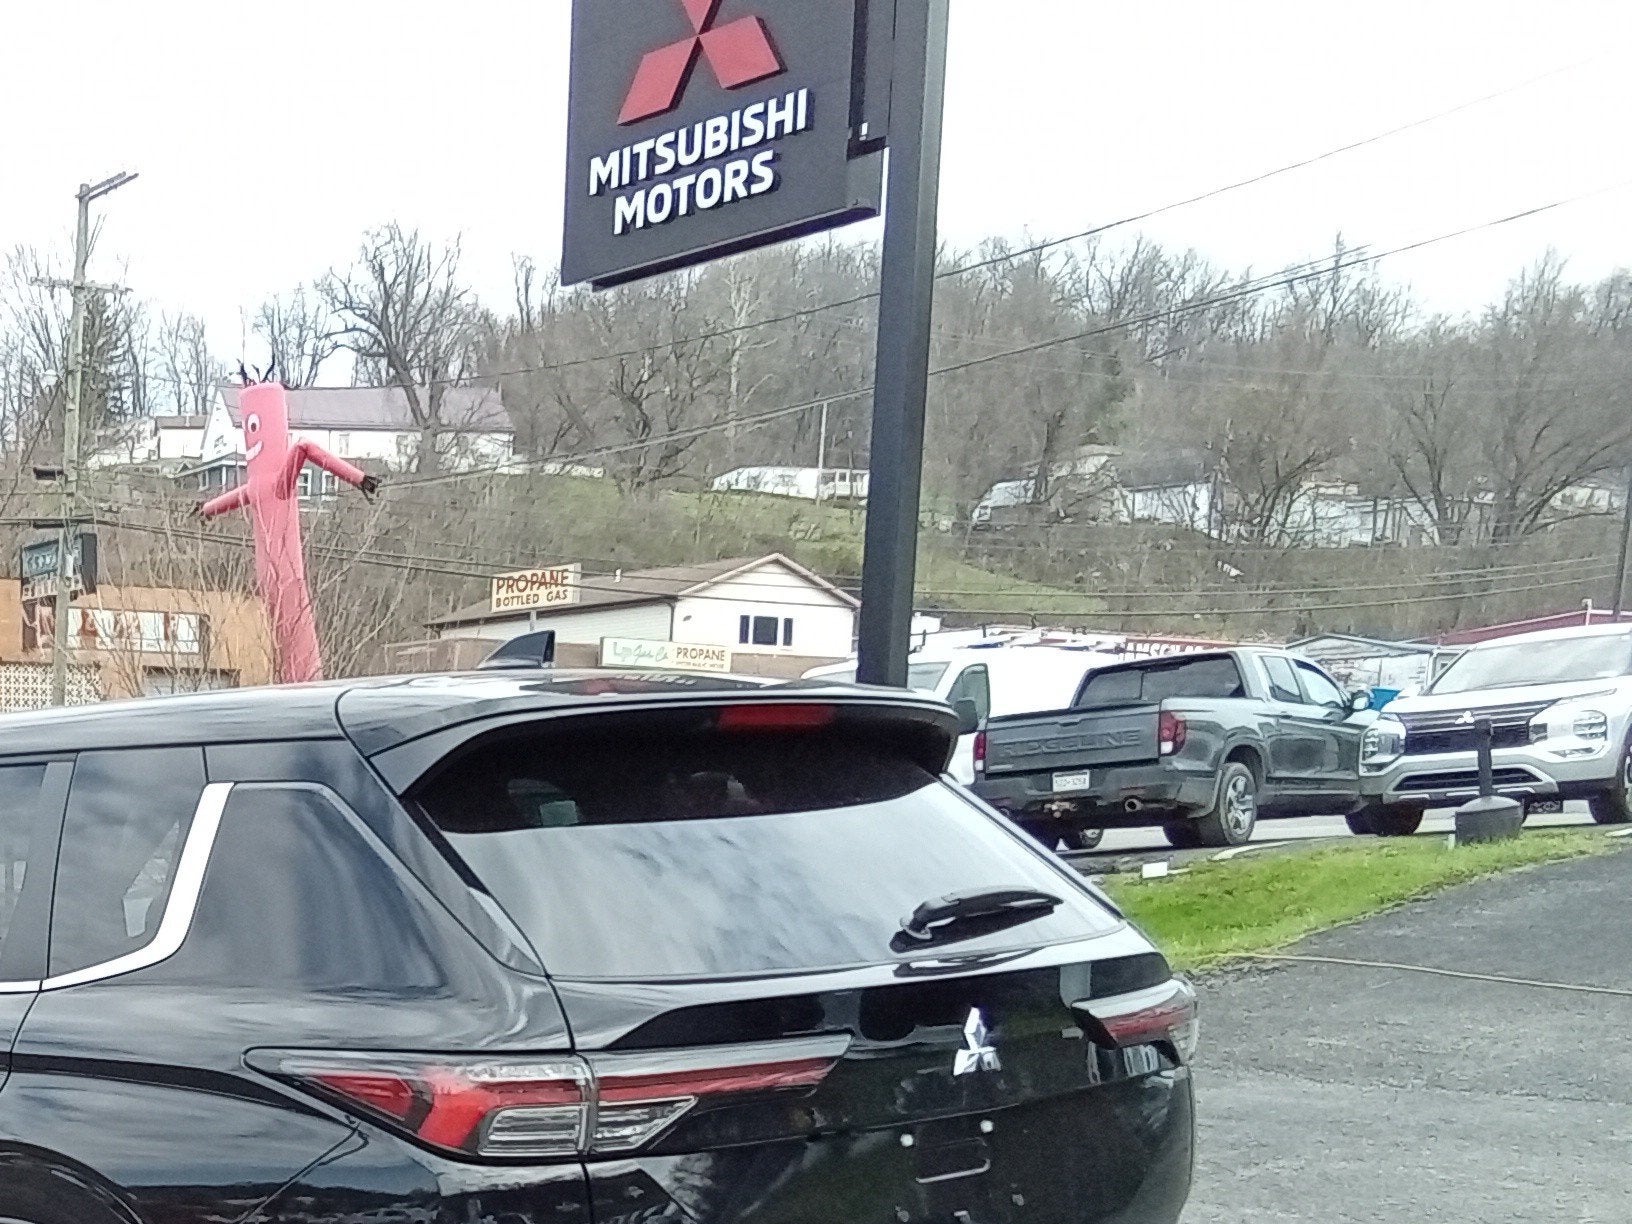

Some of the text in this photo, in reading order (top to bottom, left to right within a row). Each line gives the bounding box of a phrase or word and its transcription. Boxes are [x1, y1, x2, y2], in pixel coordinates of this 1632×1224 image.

[588, 88, 808, 196] MITSUBISHI
[613, 150, 775, 235] MOTORS
[496, 569, 570, 595] PROPANE
[495, 588, 568, 608] BOTTLED GAS
[676, 646, 725, 662] PROPANE
